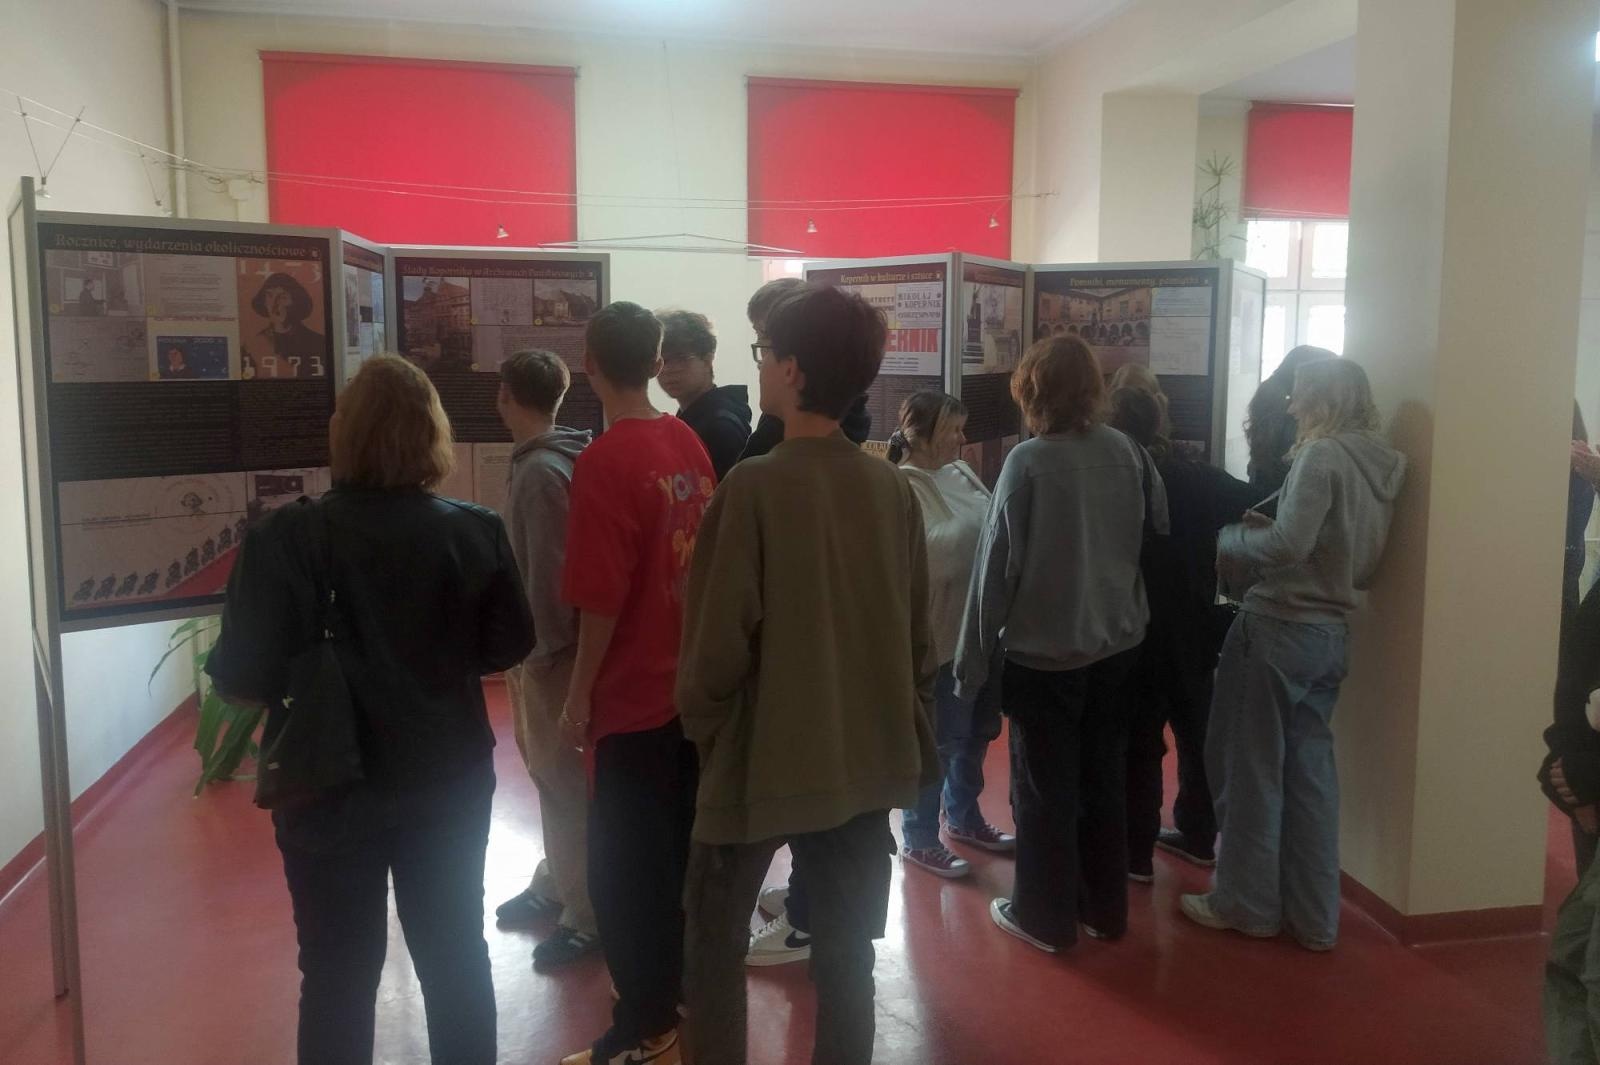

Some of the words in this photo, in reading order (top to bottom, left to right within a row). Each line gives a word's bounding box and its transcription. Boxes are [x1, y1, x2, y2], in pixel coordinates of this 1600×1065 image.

[123, 237, 203, 253] wydarzenia
[204, 239, 306, 257] okolicznościowe
[243, 355, 325, 377] 1973
